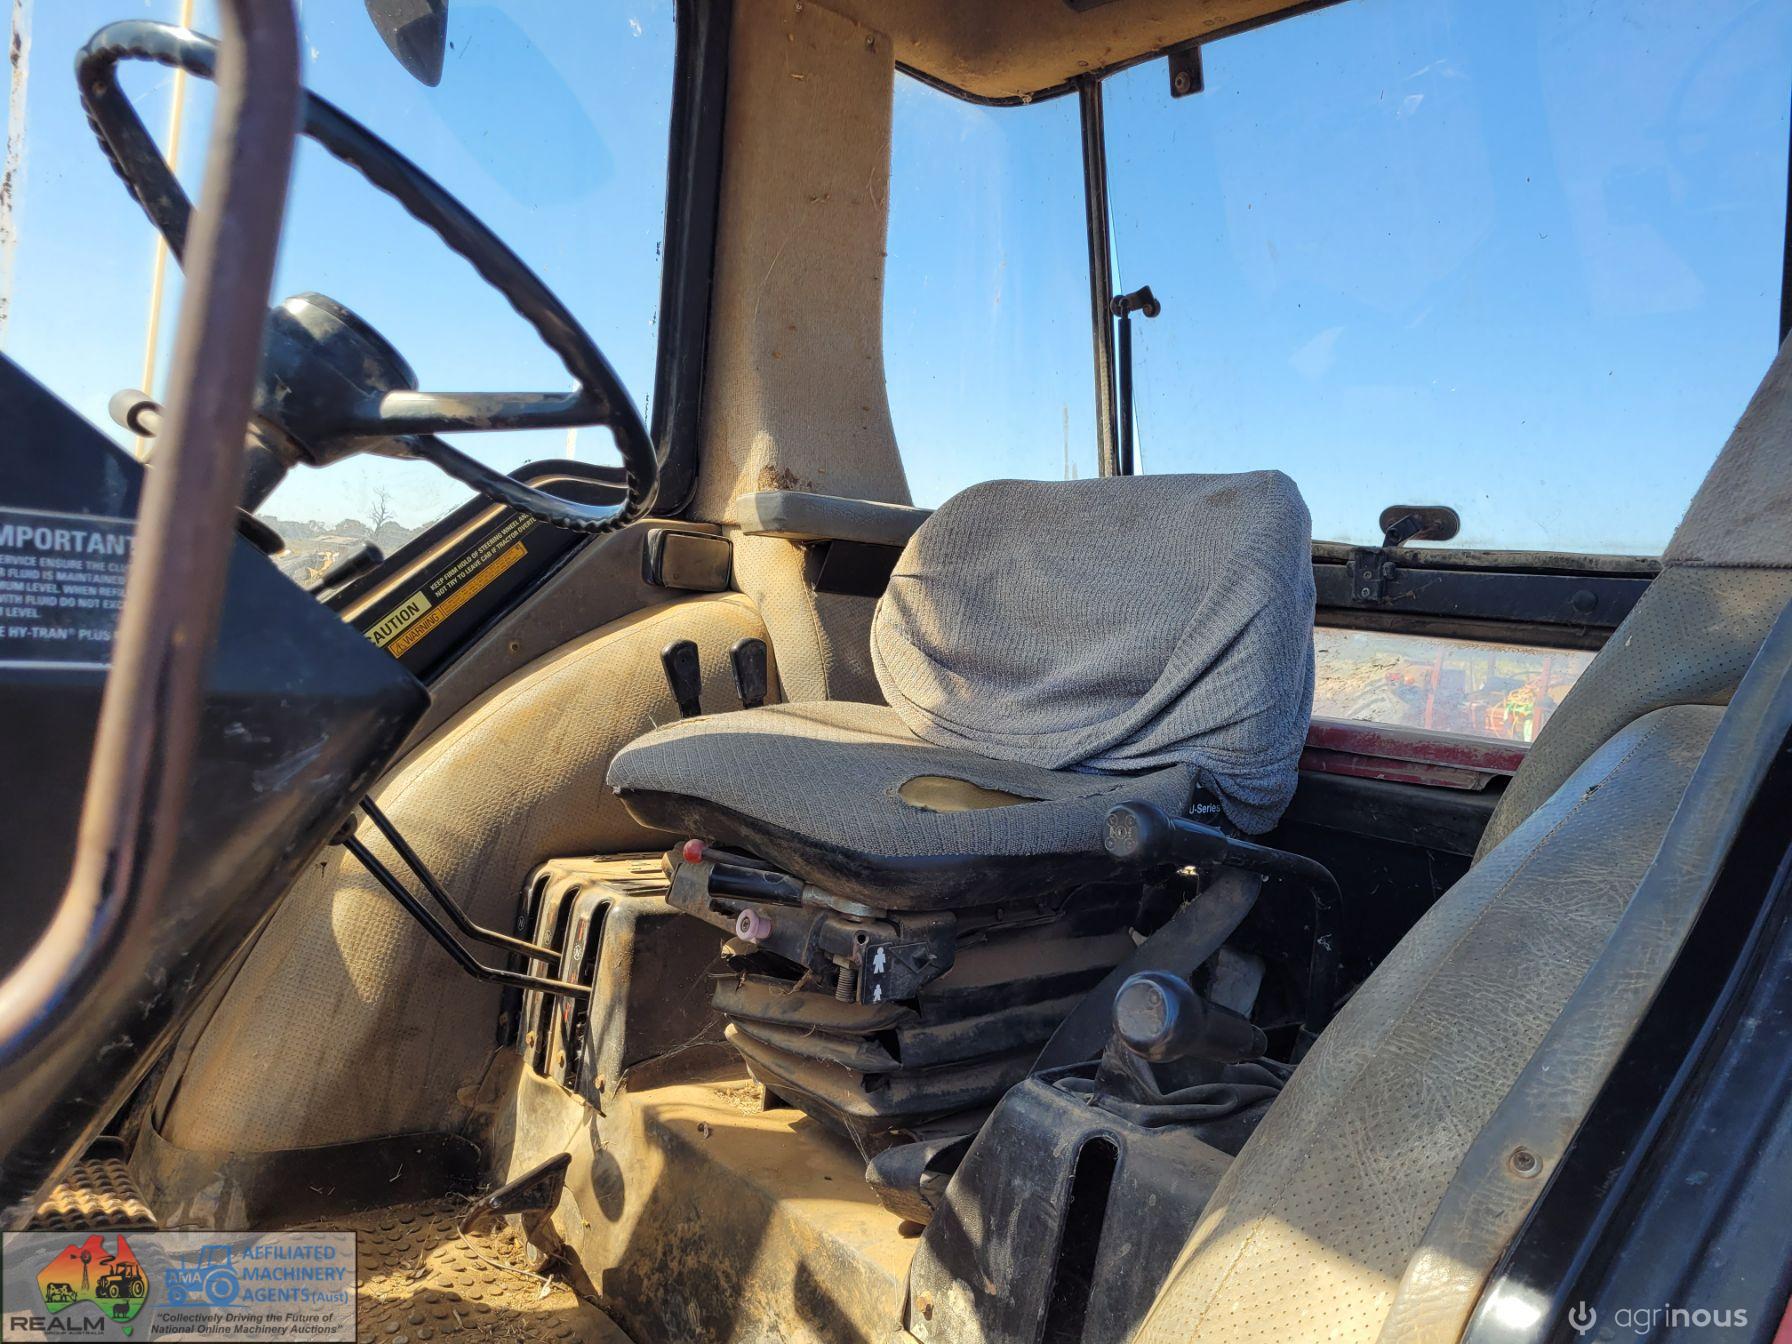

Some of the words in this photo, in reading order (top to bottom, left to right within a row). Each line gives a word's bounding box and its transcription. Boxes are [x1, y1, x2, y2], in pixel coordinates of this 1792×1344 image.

[430, 577, 445, 591] KEEP
[457, 556, 472, 570] HOLD
[471, 550, 480, 559] OF
[477, 531, 502, 553] STEERING
[500, 519, 519, 535] WHEEL
[435, 585, 447, 597] NOT
[447, 577, 458, 588] TRY
[457, 571, 466, 580] TO
[464, 559, 481, 574] LEAVE
[480, 550, 492, 562] CAB
[495, 529, 518, 550] TRACTOR
[39, 557, 82, 569] ENSURE
[86, 561, 106, 571] THE
[7, 568, 40, 579] FLUID
[42, 570, 54, 580] IS
[56, 571, 125, 584] MAINTAINED
[62, 585, 97, 595] WHEN
[25, 595, 58, 606] FLUID
[59, 597, 76, 607] DO
[77, 598, 100, 608] NOT
[368, 602, 420, 644] AUTION
[403, 613, 440, 644] WARNING
[78, 629, 111, 641] PLUS
